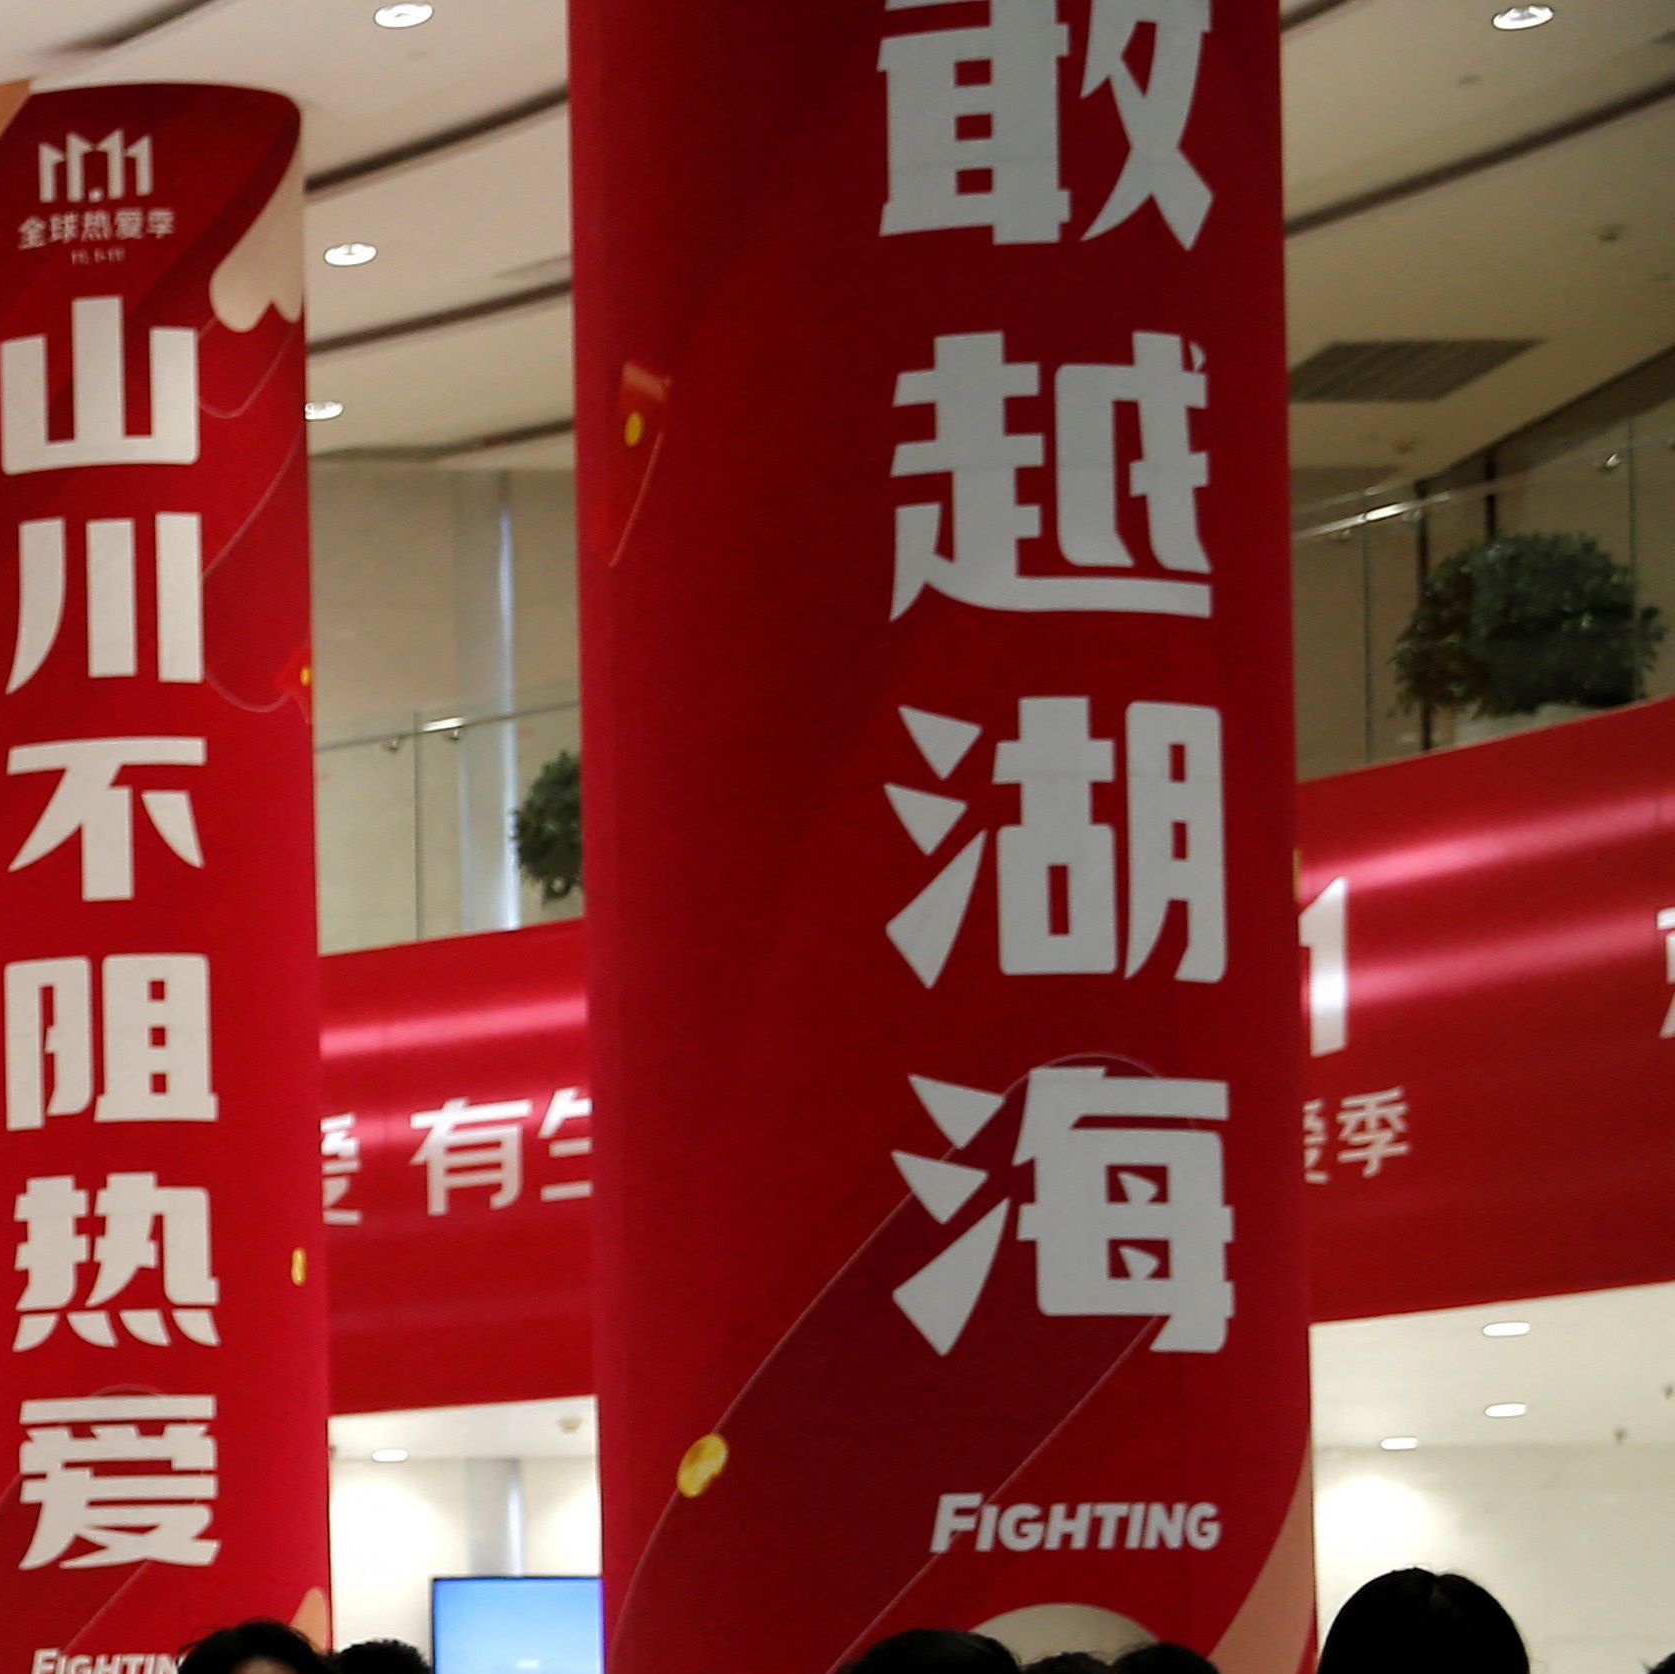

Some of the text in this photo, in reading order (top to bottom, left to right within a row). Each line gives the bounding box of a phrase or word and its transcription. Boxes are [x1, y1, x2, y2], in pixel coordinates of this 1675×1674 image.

[18, 208, 175, 251] 全球热爱季
[877, 0, 1235, 1354] 敢越湖海
[0, 296, 220, 1570] 山川不阻热爱
